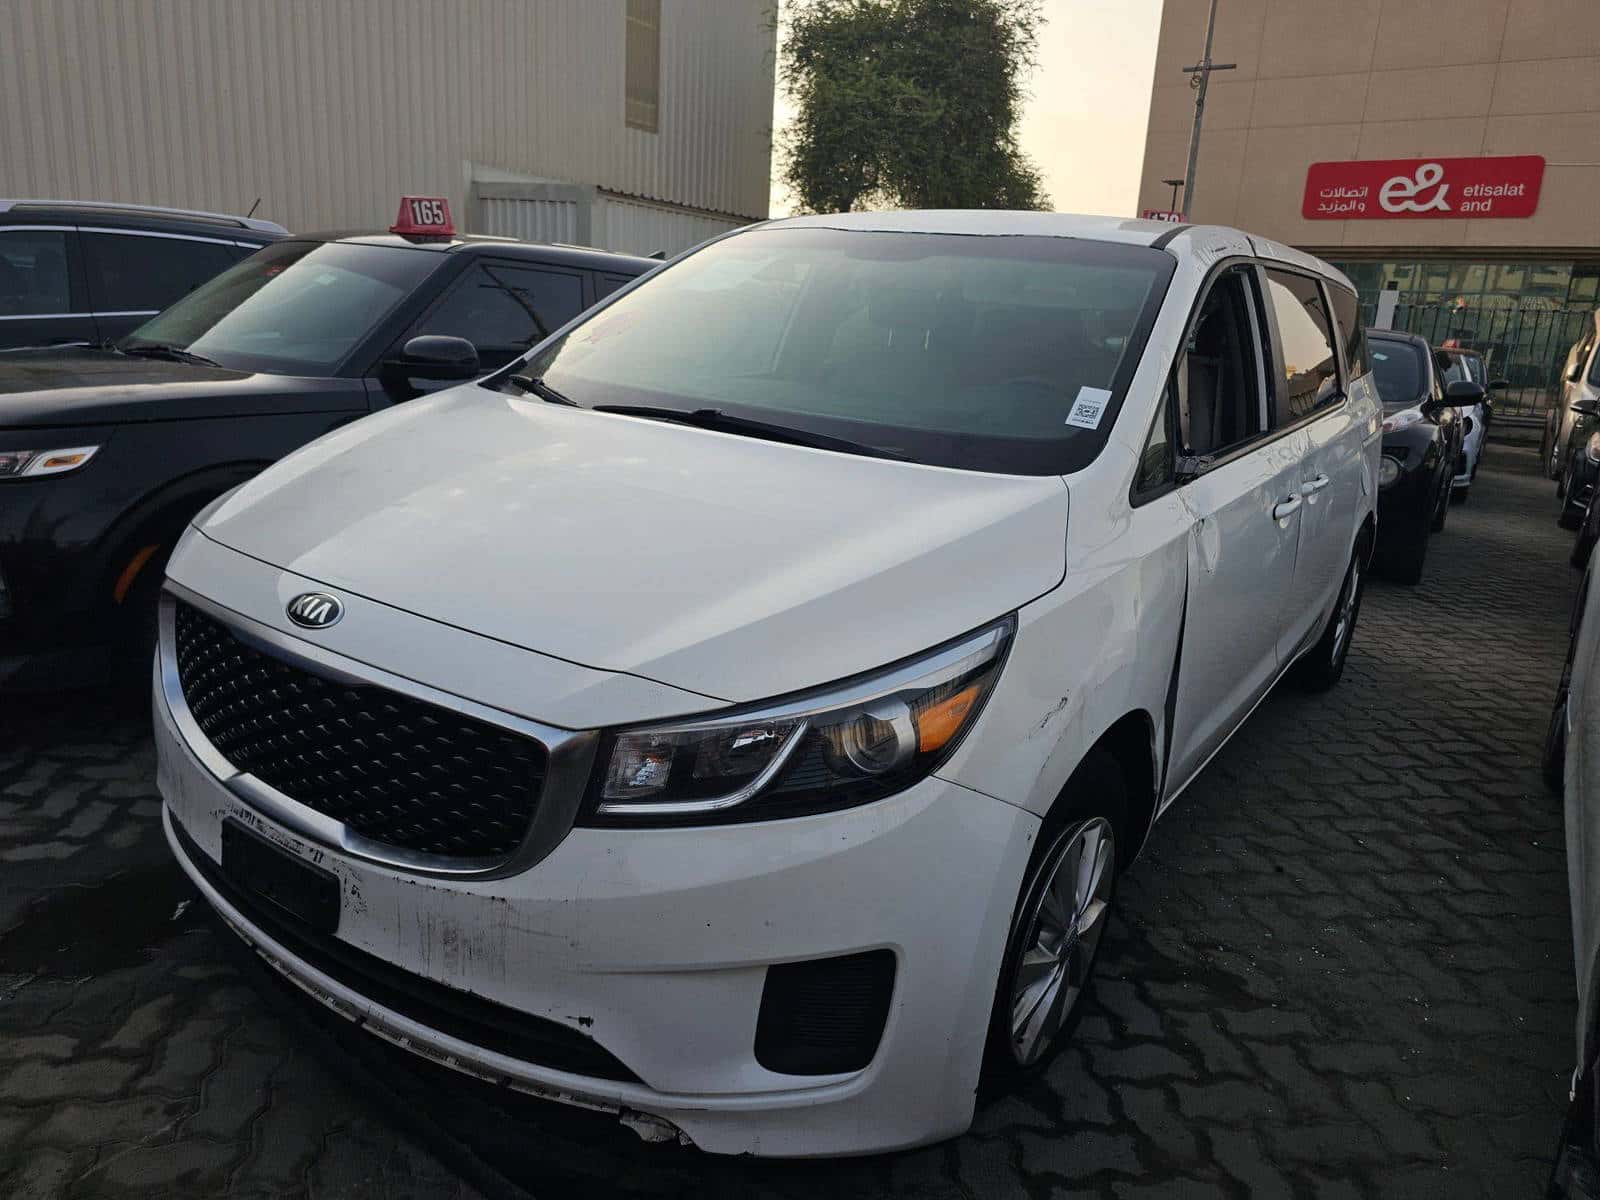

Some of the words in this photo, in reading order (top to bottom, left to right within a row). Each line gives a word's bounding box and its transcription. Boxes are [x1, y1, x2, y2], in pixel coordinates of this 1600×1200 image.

[1320, 186, 1368, 198] اتصالات
[1379, 163, 1451, 213] e&
[1463, 183, 1525, 197] etisalat
[412, 201, 444, 225] 165
[1460, 199, 1492, 213] and
[290, 595, 332, 624] KIA
